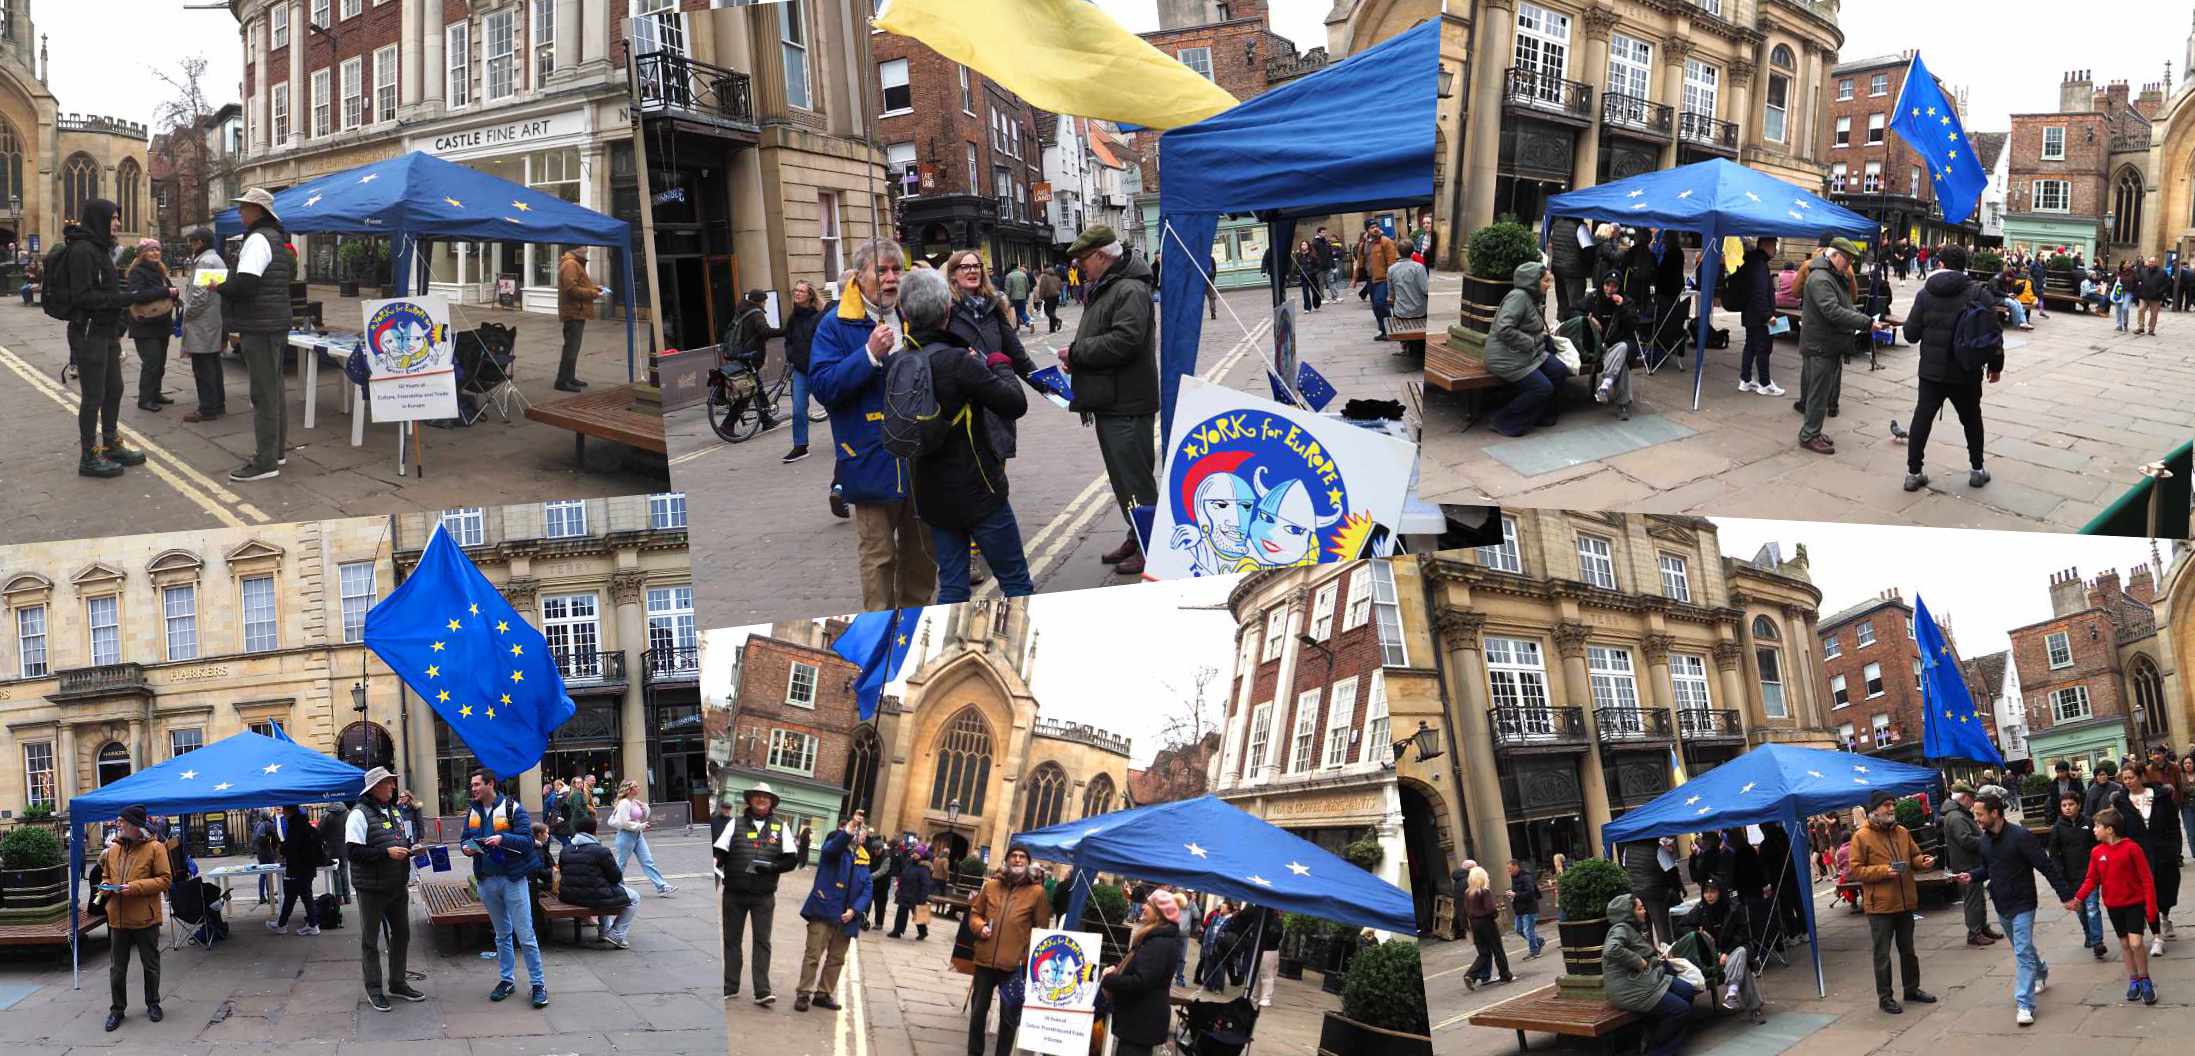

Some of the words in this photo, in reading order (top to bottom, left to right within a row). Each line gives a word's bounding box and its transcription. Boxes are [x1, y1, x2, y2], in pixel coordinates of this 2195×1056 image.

[435, 132, 480, 151] CASTLE
[486, 125, 515, 142] FINE
[520, 119, 550, 137] ART
[1261, 418, 1282, 440] for
[170, 664, 229, 682] HARKERS
